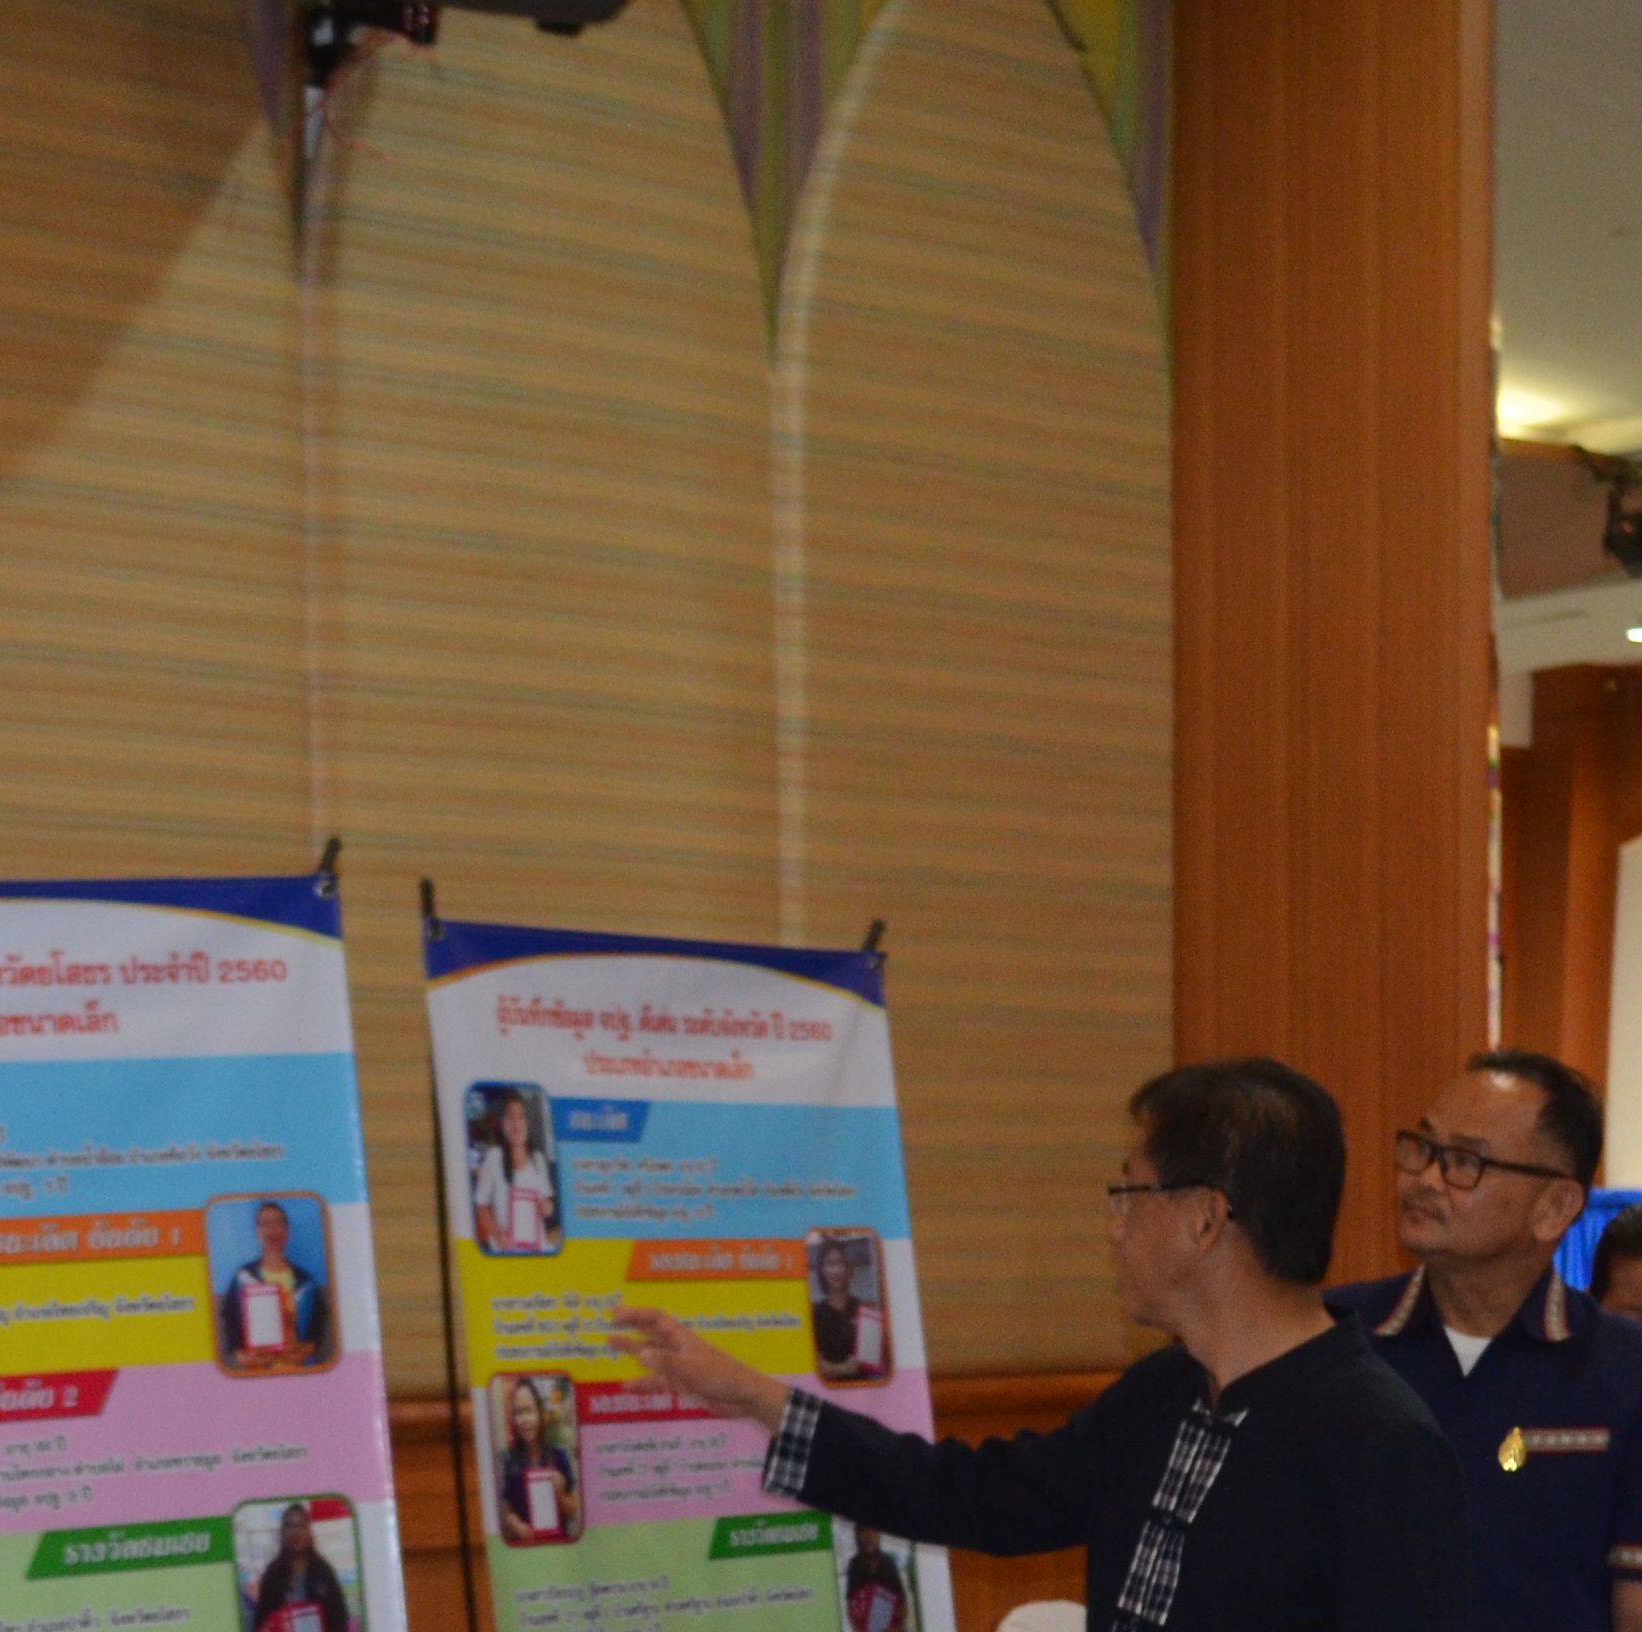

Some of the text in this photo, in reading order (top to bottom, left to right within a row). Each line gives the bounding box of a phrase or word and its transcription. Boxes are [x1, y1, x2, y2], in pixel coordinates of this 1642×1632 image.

[119, 950, 210, 986] ประจำปี
[217, 958, 288, 984] 2560
[790, 1020, 833, 1043] 2560
[64, 1386, 79, 1408] 2
